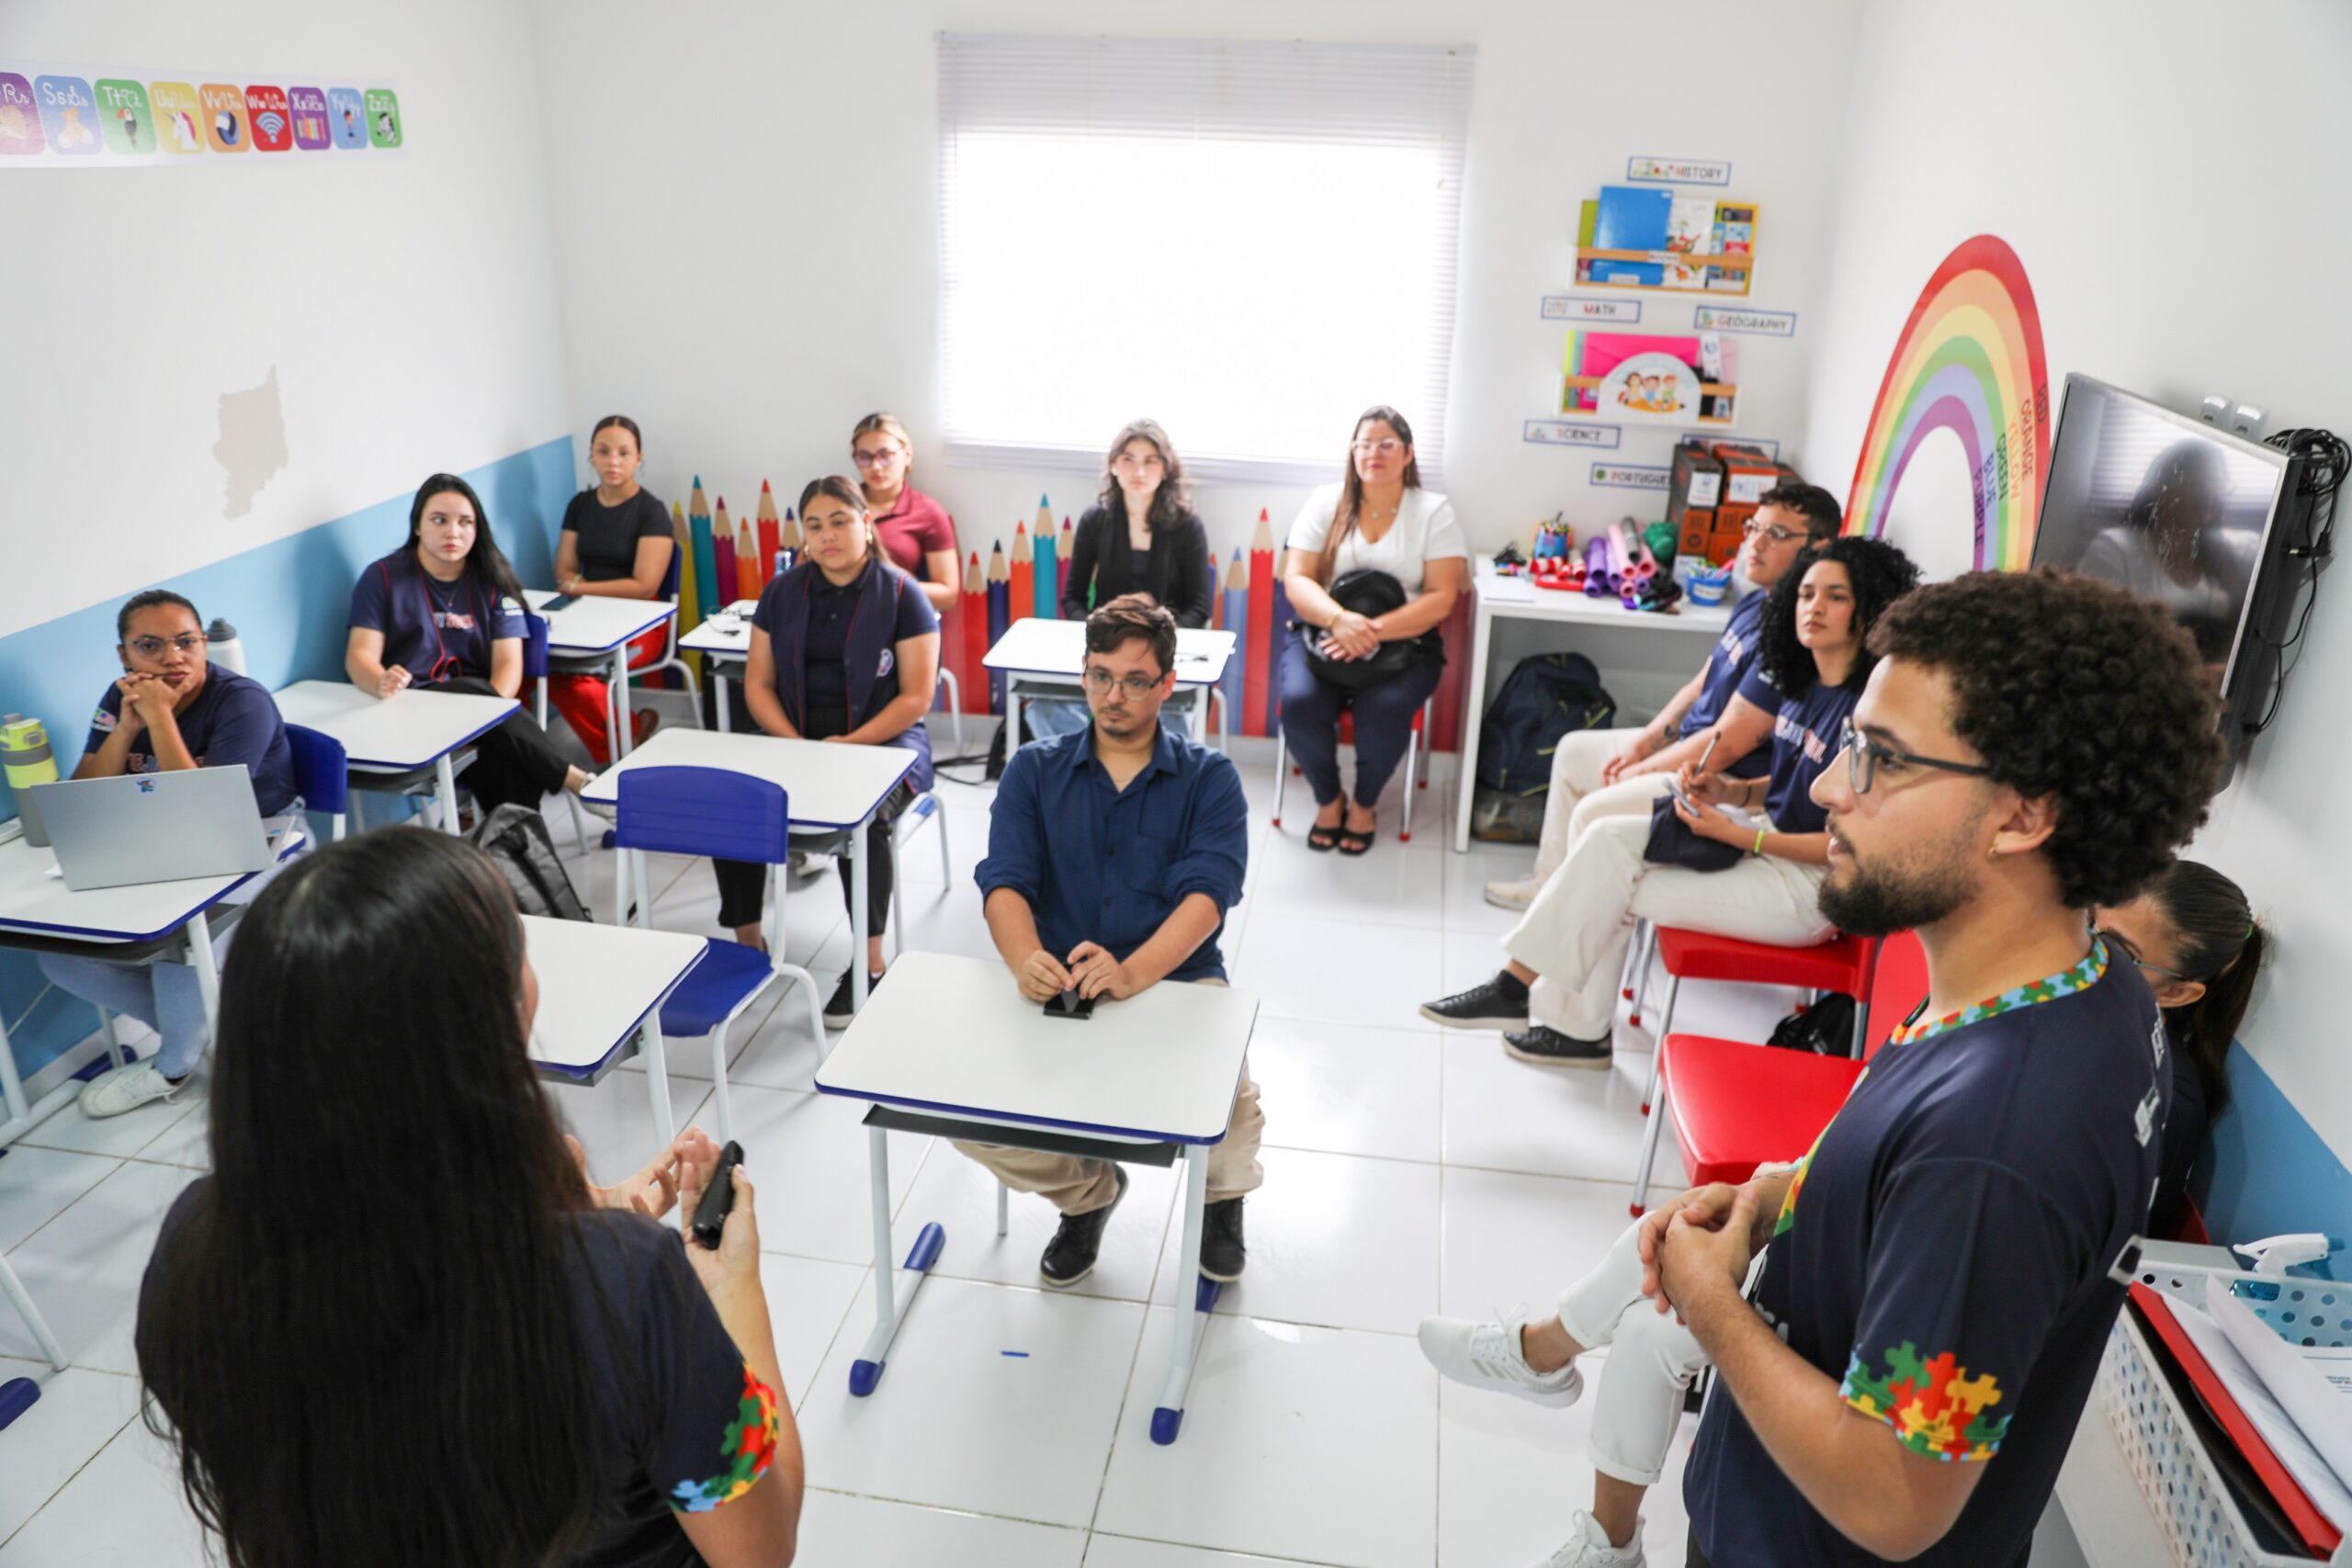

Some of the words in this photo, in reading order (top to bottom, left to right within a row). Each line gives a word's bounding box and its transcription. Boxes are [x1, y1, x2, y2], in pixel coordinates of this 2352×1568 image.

[1676, 165, 1724, 179] HISTORY
[1583, 304, 1616, 316] MATH
[1717, 314, 1788, 330] GEOGRAPHY
[2037, 384, 2048, 423] RED
[1557, 427, 1601, 442] SCIENCE
[2021, 399, 2033, 482] ORANGE
[1984, 452, 1996, 508] BLUE
[1996, 433, 2009, 502] GREEN
[1974, 467, 1985, 546] PURPLE
